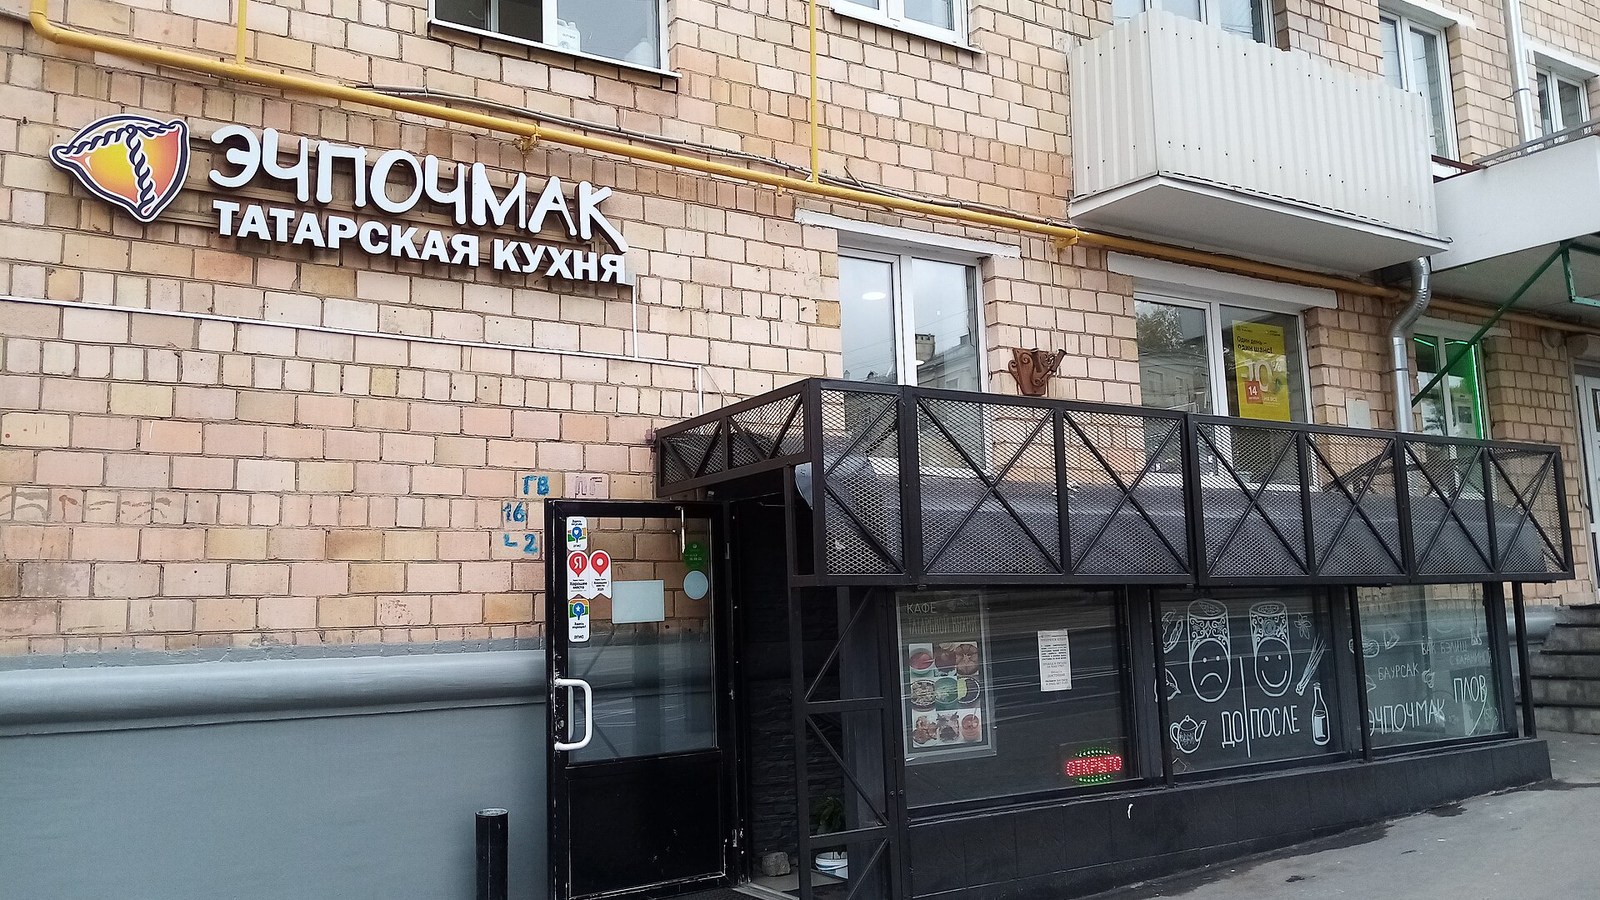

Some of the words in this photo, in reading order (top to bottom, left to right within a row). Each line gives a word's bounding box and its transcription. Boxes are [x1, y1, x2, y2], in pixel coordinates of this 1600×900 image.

[208, 124, 629, 254] ЭЧПОЧМАК
[212, 200, 479, 267] ТАТАРСКАЯ
[493, 238, 627, 284] КУХНЯ
[1248, 385, 1258, 396] 14
[502, 501, 526, 523] 16
[523, 533, 539, 554] 2
[573, 556, 582, 570] Я
[906, 601, 937, 614] КАФЕ
[1377, 662, 1420, 681] БАУРСАК
[1453, 674, 1488, 704] ПЛОВ
[1221, 710, 1245, 749] ДО
[1249, 705, 1300, 740] ПОСЛЕ
[1367, 698, 1446, 737] ЭЧПОЧМАК
[1066, 756, 1122, 777] ОТКРЫТО
